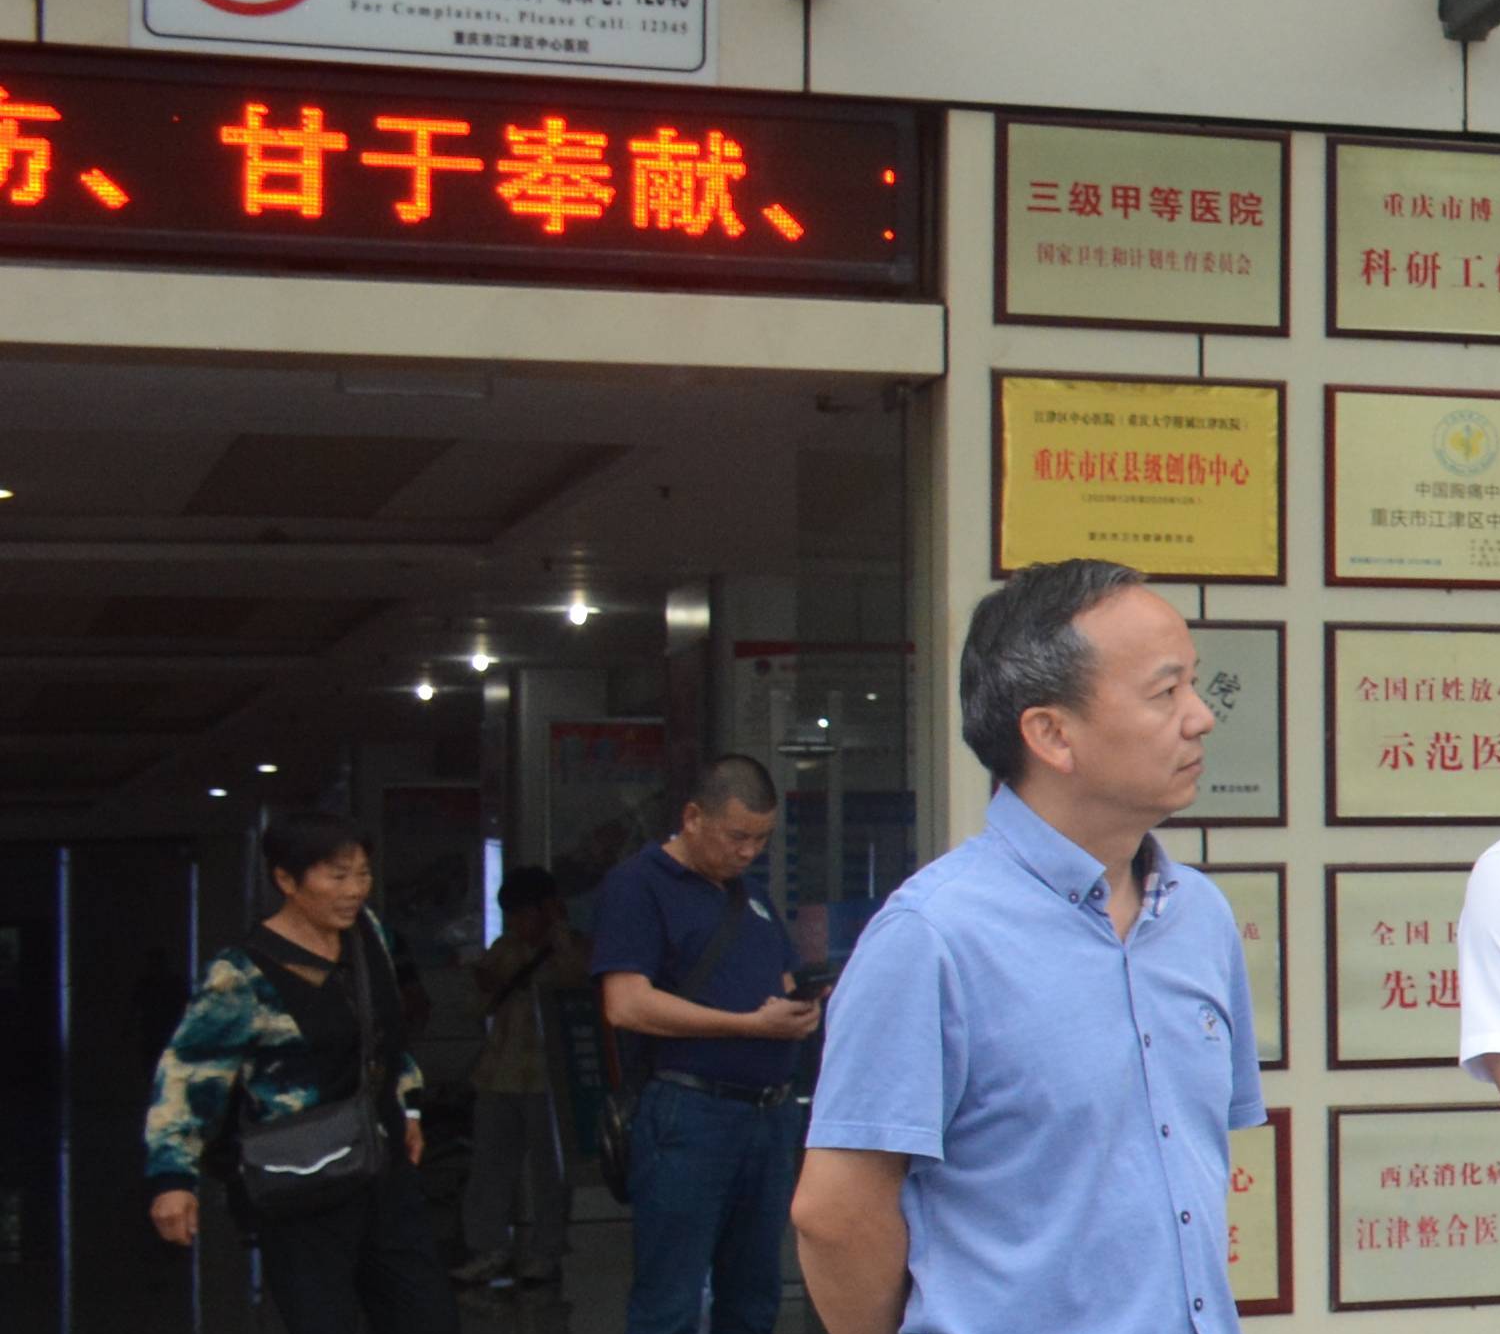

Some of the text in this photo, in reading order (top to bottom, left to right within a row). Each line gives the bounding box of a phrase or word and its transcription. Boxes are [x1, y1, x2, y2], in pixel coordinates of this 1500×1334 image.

[519, 10, 576, 27] Please
[641, 21, 688, 34] 12345
[454, 30, 589, 53] 重庆市江津区中心医院
[1027, 181, 1264, 227] 三级甲等医院
[1036, 242, 1252, 276] 国家卫生和计划生育委员会
[1033, 448, 1250, 487] 重庆市区县级创伤中心
[1381, 970, 1462, 1011] 先进
